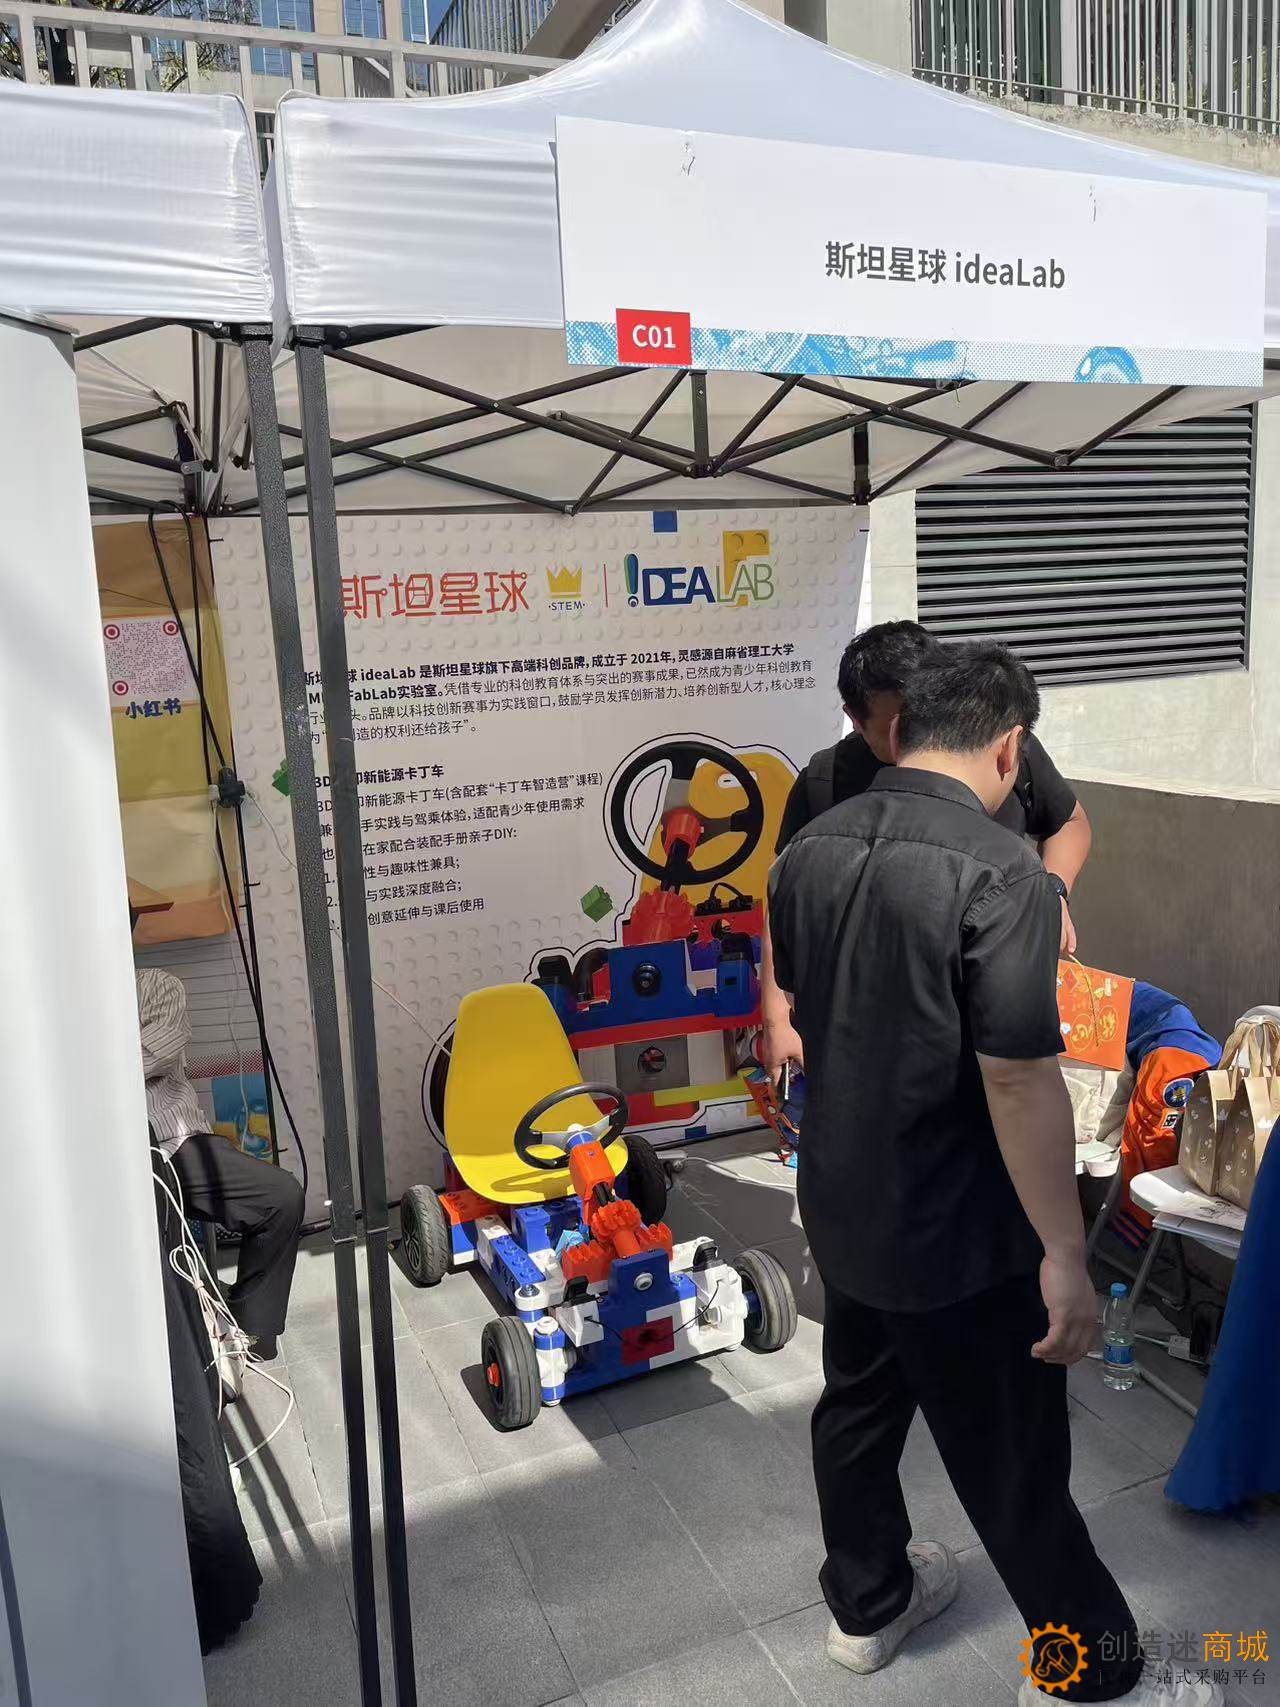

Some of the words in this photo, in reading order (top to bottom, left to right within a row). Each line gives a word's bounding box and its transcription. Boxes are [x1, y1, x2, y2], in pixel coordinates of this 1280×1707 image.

[825, 240, 948, 284] 斯坦星球
[955, 251, 1066, 289] ideaLab
[631, 324, 676, 349] C01
[341, 570, 530, 619] 斯坦星球
[360, 666, 416, 682] ideaLab
[125, 698, 182, 719] 小红书
